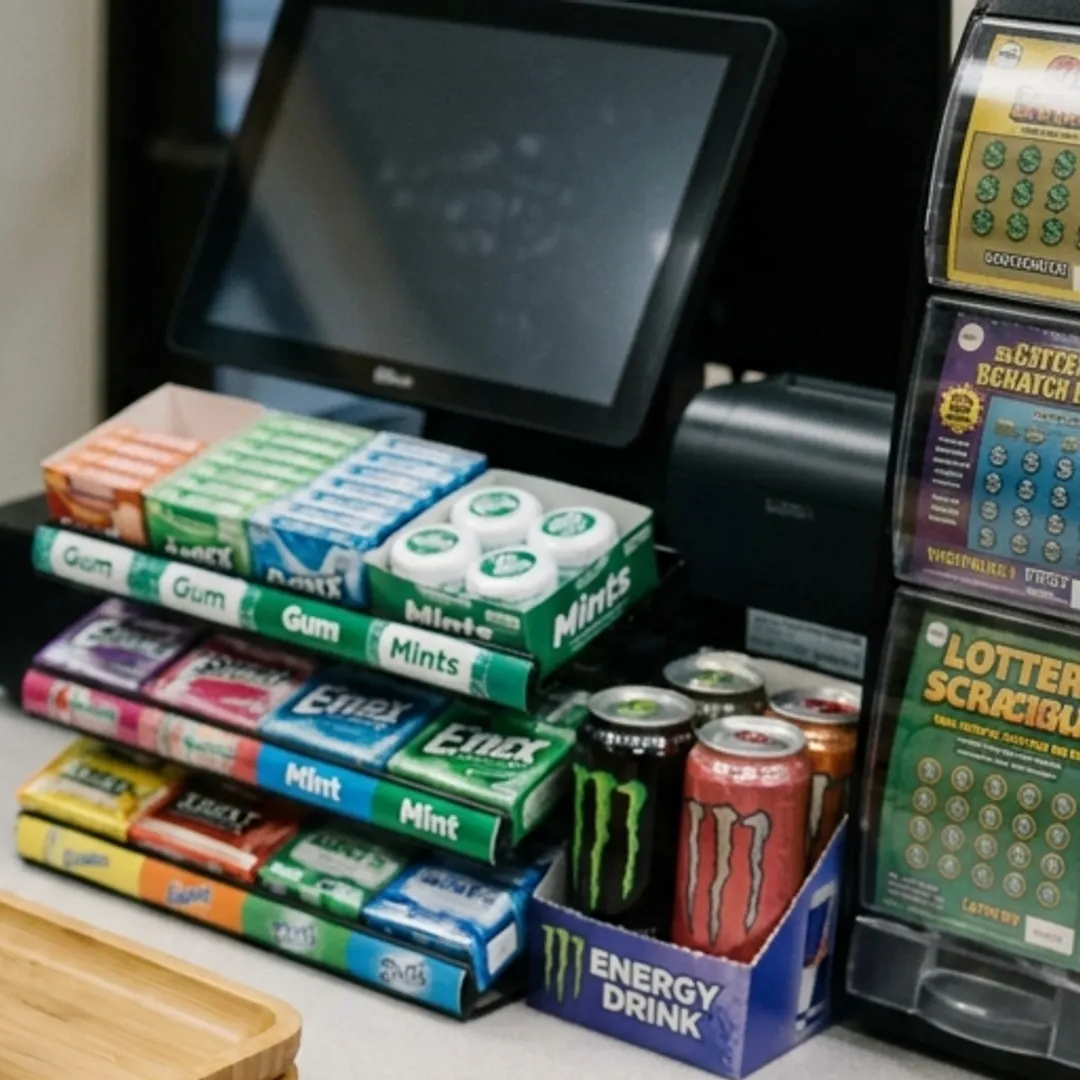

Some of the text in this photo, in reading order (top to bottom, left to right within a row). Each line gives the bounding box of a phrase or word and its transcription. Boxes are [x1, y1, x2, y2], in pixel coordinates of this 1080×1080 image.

[62, 546, 113, 579] Gum
[172, 577, 226, 610] Gum
[281, 605, 340, 642] Gum
[390, 637, 460, 676] Mints
[552, 565, 632, 649] Mints
[285, 762, 460, 841] Mint Mint
[589, 946, 720, 1011] ENERGY
[602, 982, 703, 1039] DRINK
